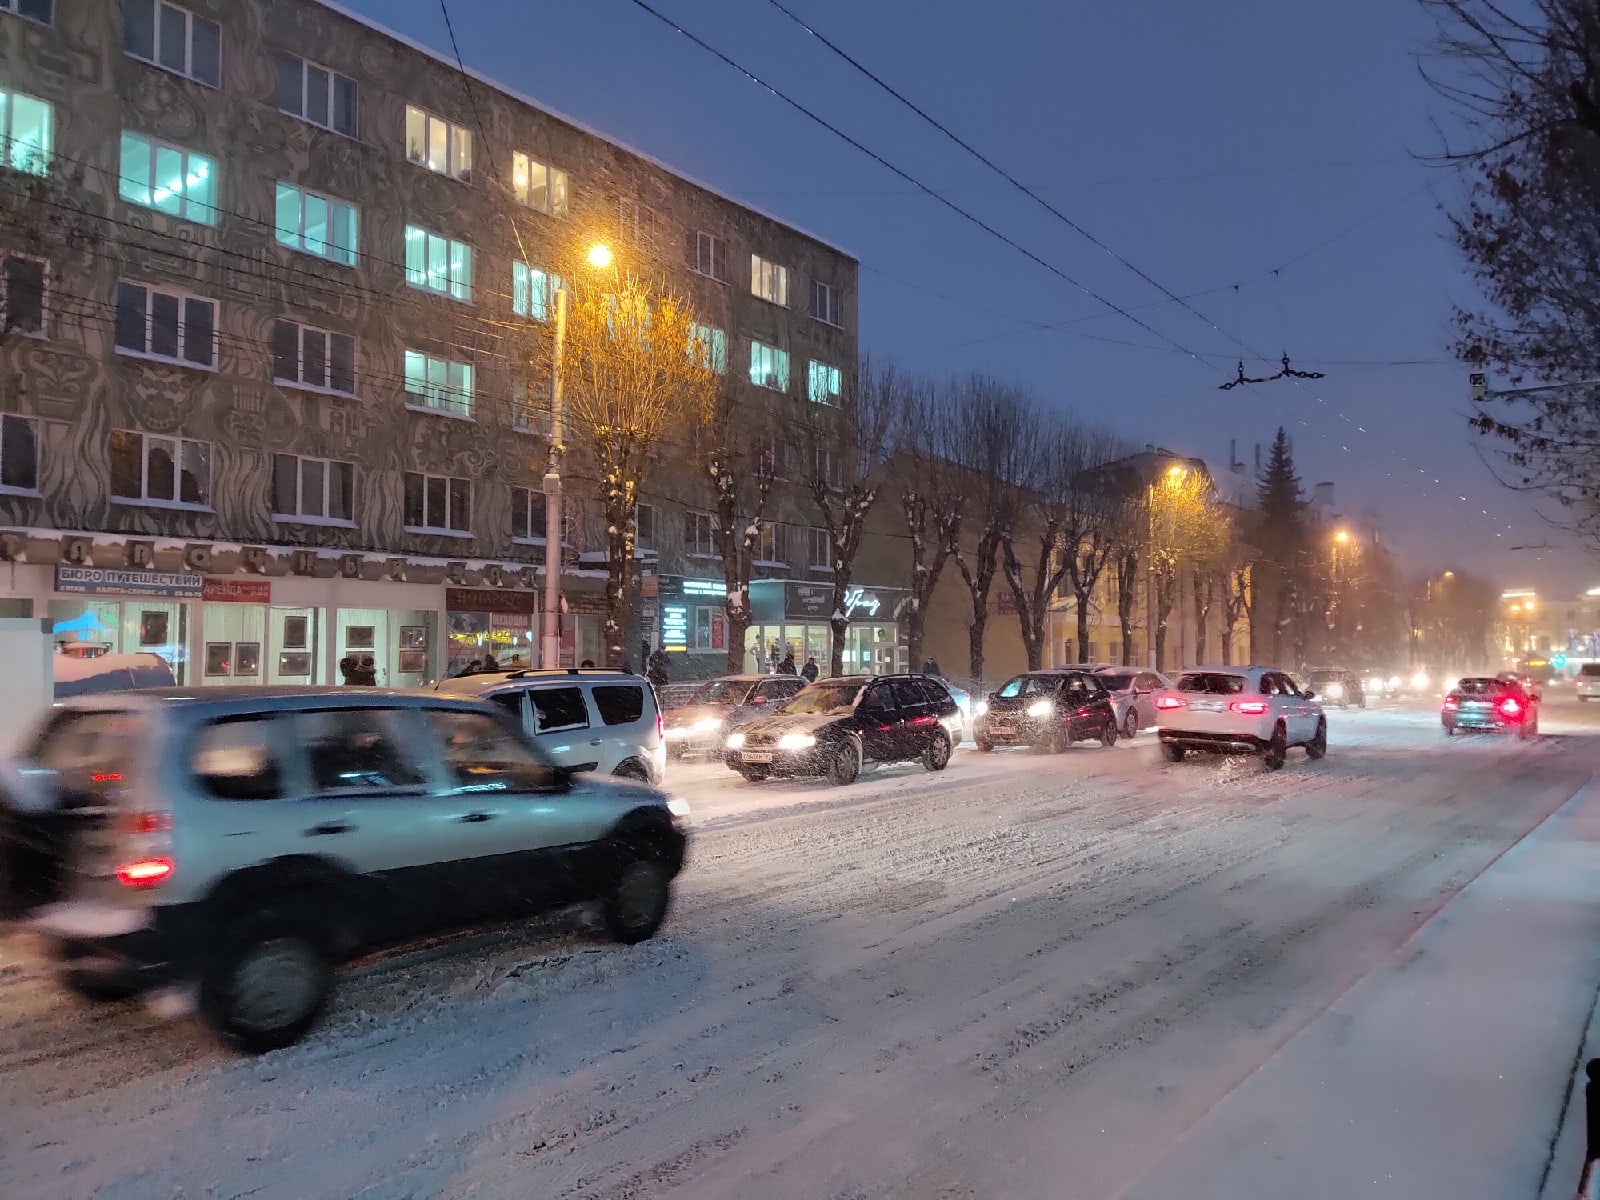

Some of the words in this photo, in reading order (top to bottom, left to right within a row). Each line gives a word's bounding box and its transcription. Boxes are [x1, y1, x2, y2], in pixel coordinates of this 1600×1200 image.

[61, 569, 102, 582] БЮРО
[107, 571, 201, 586] ПУТЕШЕСТВИЙ
[203, 584, 243, 597] АРЕНДА
